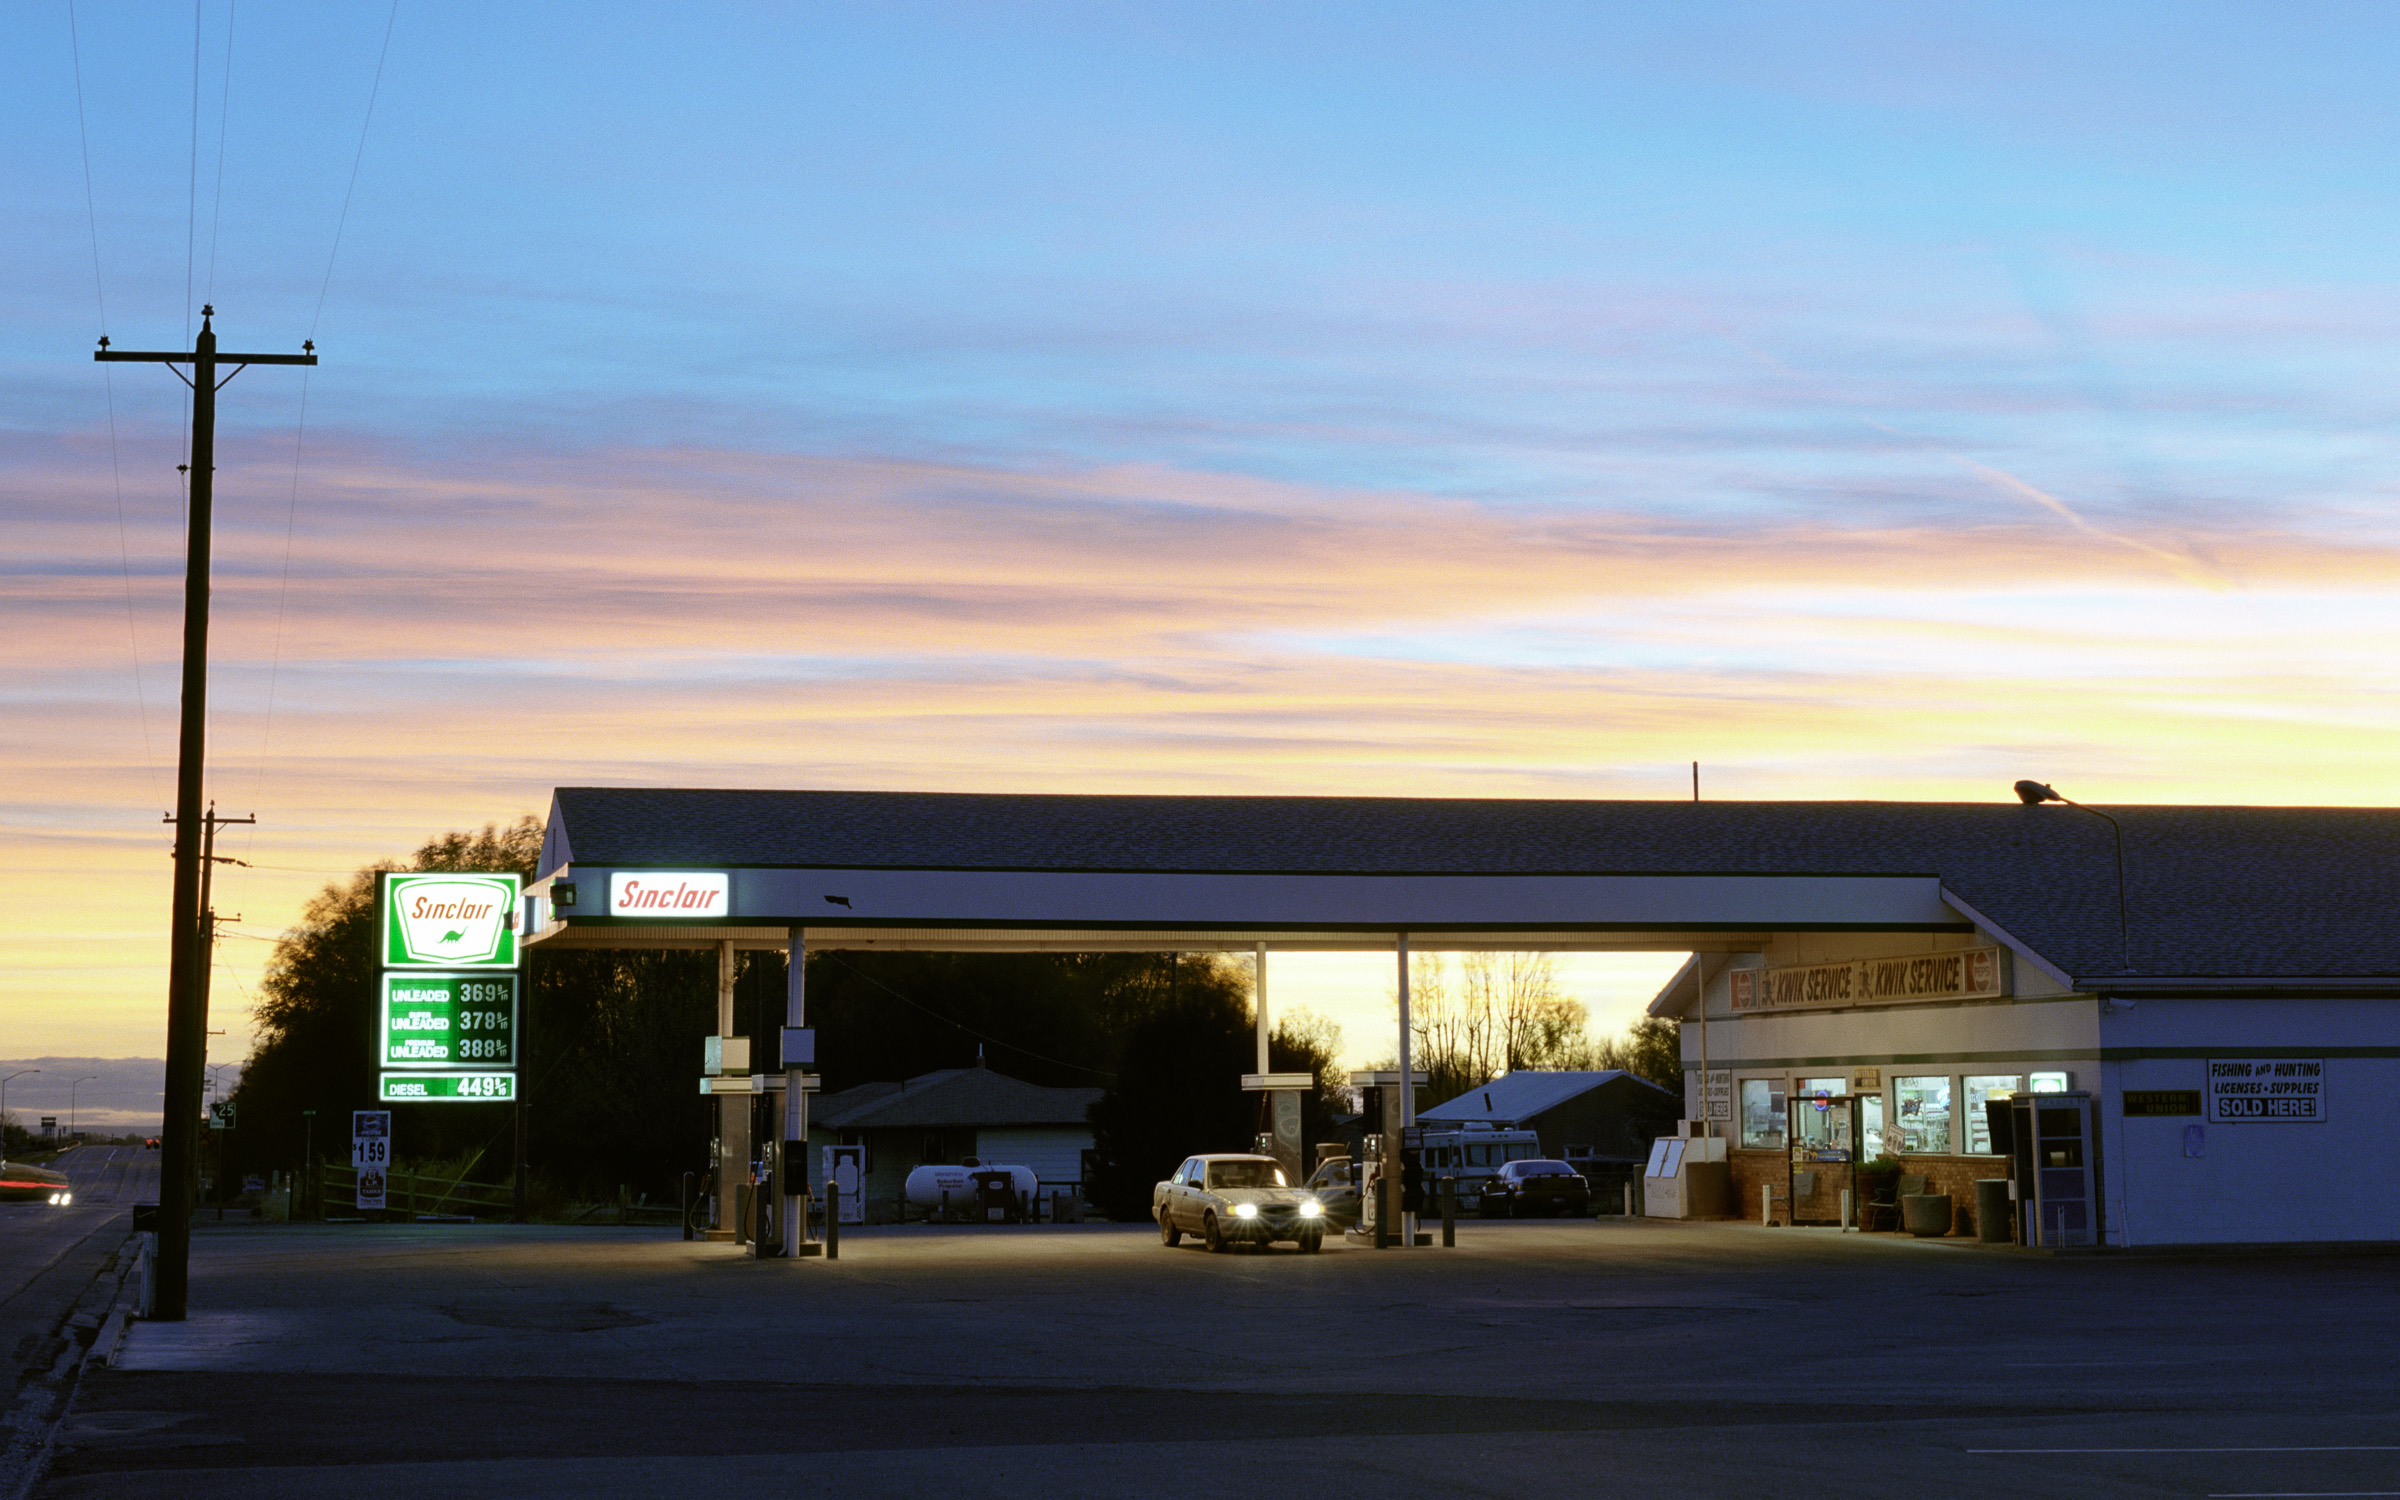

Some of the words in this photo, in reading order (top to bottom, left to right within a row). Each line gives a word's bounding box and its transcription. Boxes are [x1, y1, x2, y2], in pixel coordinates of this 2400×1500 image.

[619, 880, 720, 908] Sinclair
[412, 896, 493, 919] Sinclair
[1777, 970, 1806, 1003] KWIK
[1806, 966, 1852, 1001] SERVICE
[1876, 961, 1908, 996] KWIK
[1909, 956, 1960, 994] SERVICE
[392, 989, 450, 1002] UNLEADED
[460, 983, 496, 1002] 369
[391, 1017, 449, 1030] UNLEADED
[460, 1011, 495, 1030] 378
[391, 1046, 448, 1058] UNLEADED
[459, 1039, 495, 1058] 388
[2212, 1063, 2252, 1077] FISHING
[2255, 1063, 2271, 1076] AND
[2275, 1063, 2321, 1077] HUNTING
[389, 1083, 428, 1096] DIESEL
[457, 1077, 494, 1096] 449
[2215, 1082, 2262, 1094] LICENSES
[2270, 1082, 2319, 1094] SUPPLIES
[2127, 1094, 2187, 1103] WESTERN
[2146, 1103, 2187, 1113] UNION
[2220, 1099, 2263, 1116] SOLD
[2267, 1099, 2315, 1116] HERE!
[219, 1104, 234, 1117] 25
